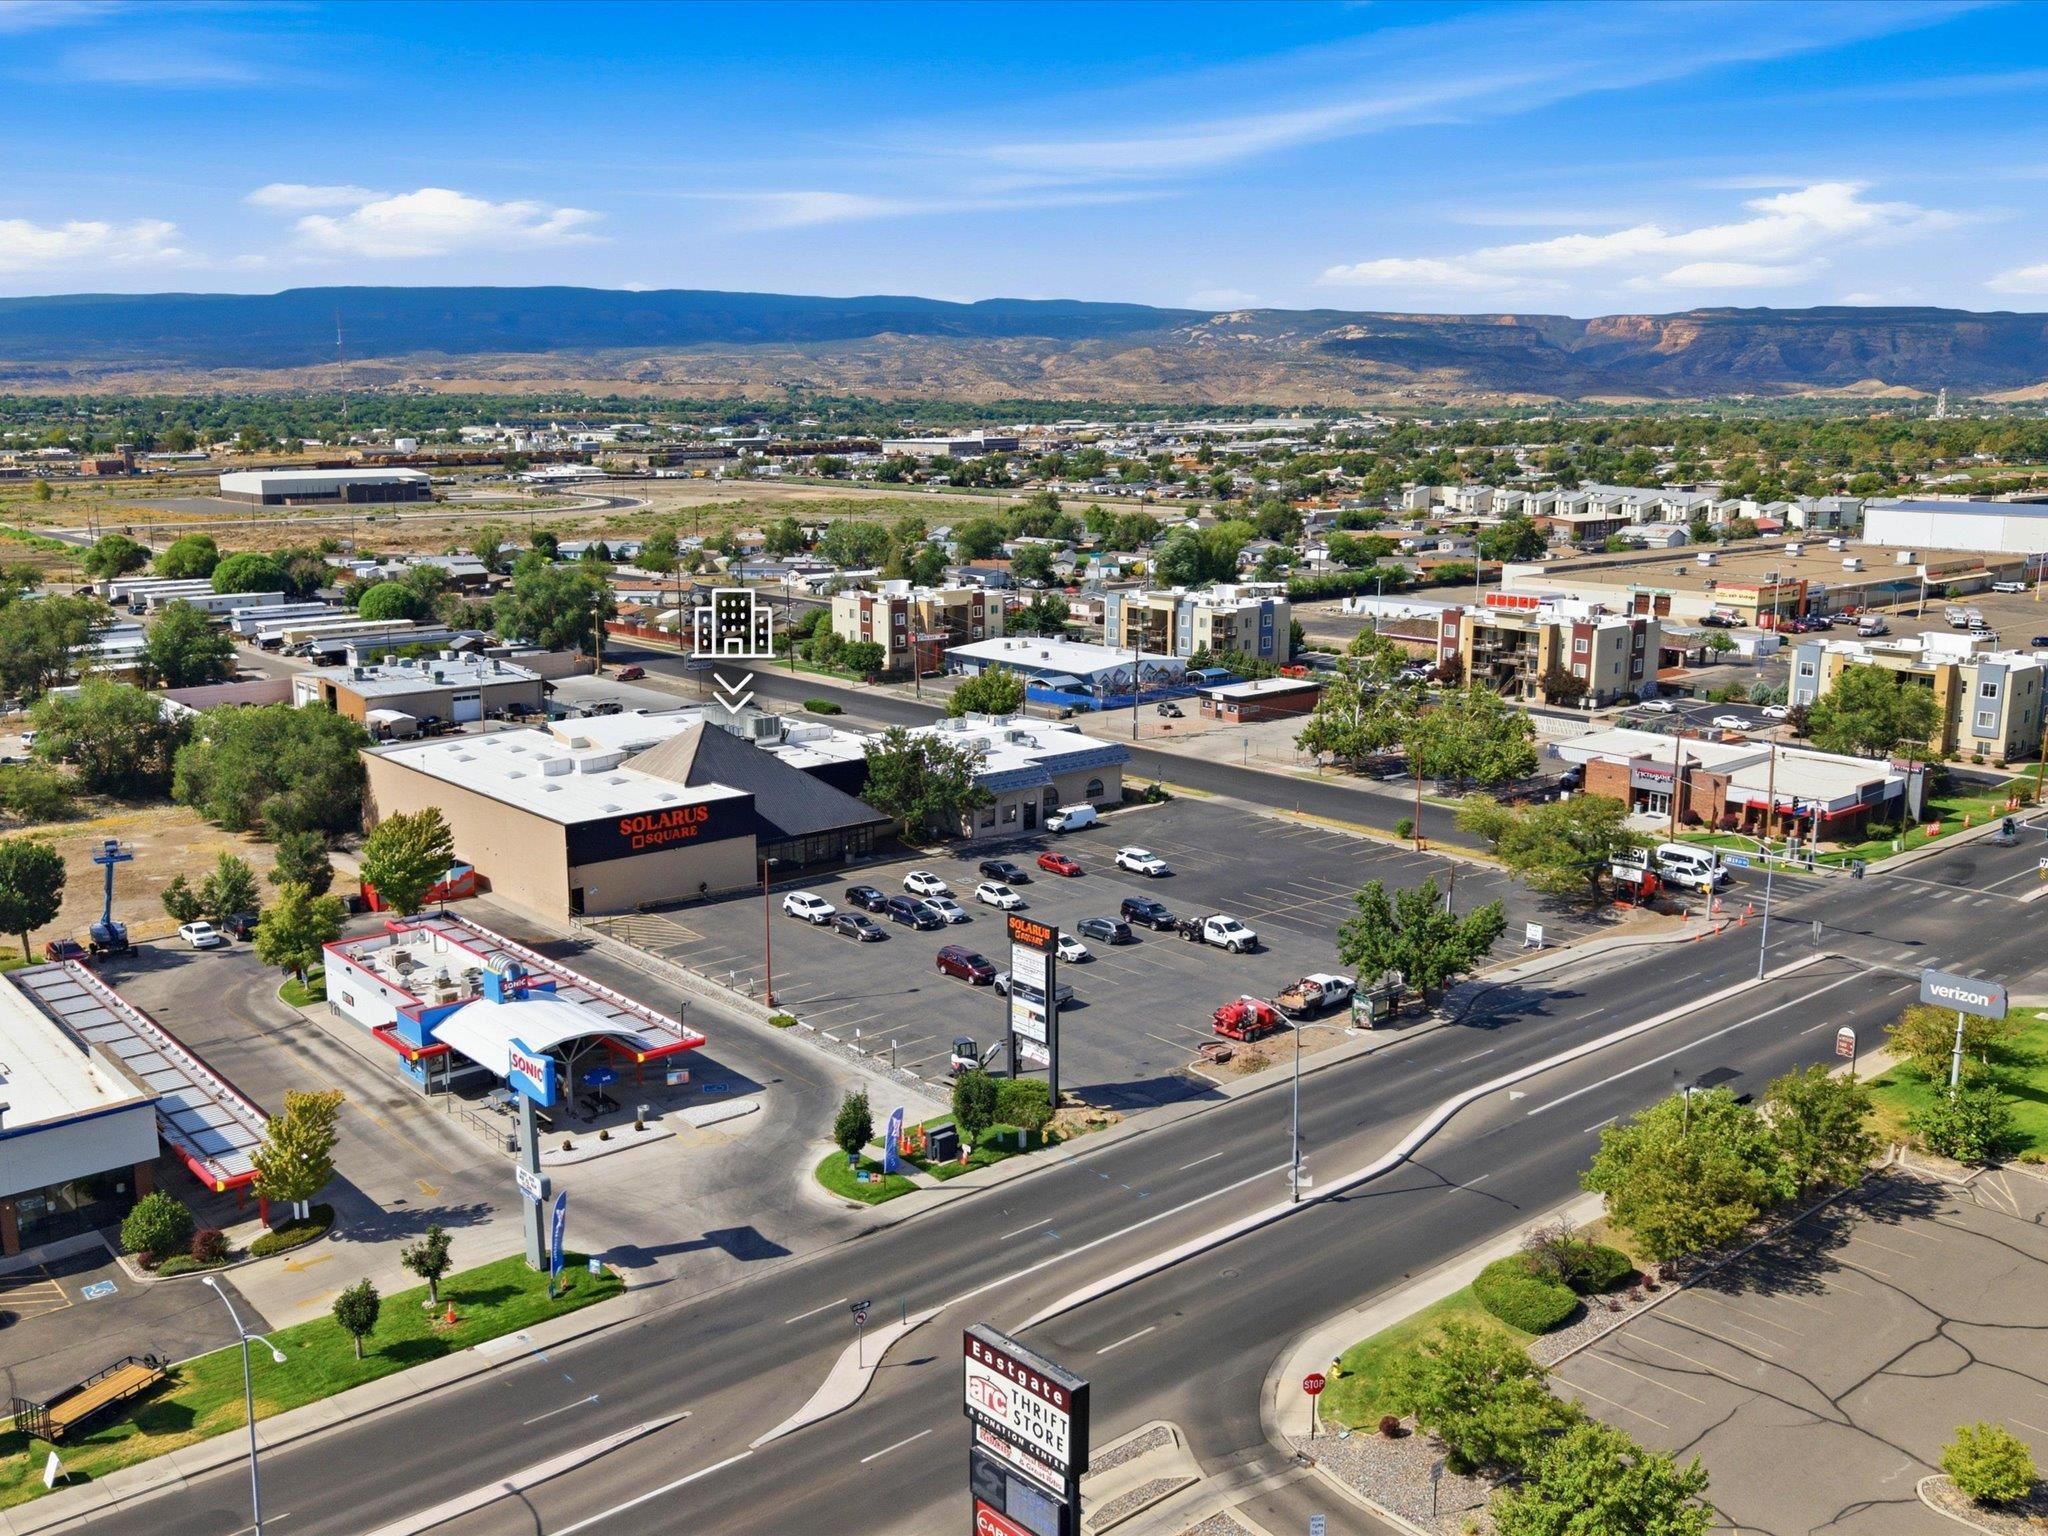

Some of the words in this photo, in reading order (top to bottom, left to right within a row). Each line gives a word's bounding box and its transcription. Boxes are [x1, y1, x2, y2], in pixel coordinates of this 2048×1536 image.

[619, 805, 709, 836] SOLARUS
[645, 825, 698, 844] SQUARE
[1009, 917, 1051, 939] SOLARUS
[1929, 983, 1989, 1007] verizon
[511, 1053, 543, 1083] SONIC
[972, 1340, 1063, 1405] Eastgate
[1304, 1379, 1325, 1390] STOP
[970, 1377, 1007, 1417] arc
[1012, 1388, 1067, 1435] THRIFT
[968, 1407, 975, 1416] A
[978, 1412, 1024, 1446] DONATION
[1029, 1444, 1066, 1472] CENTER
[1013, 1410, 1063, 1453] STORE
